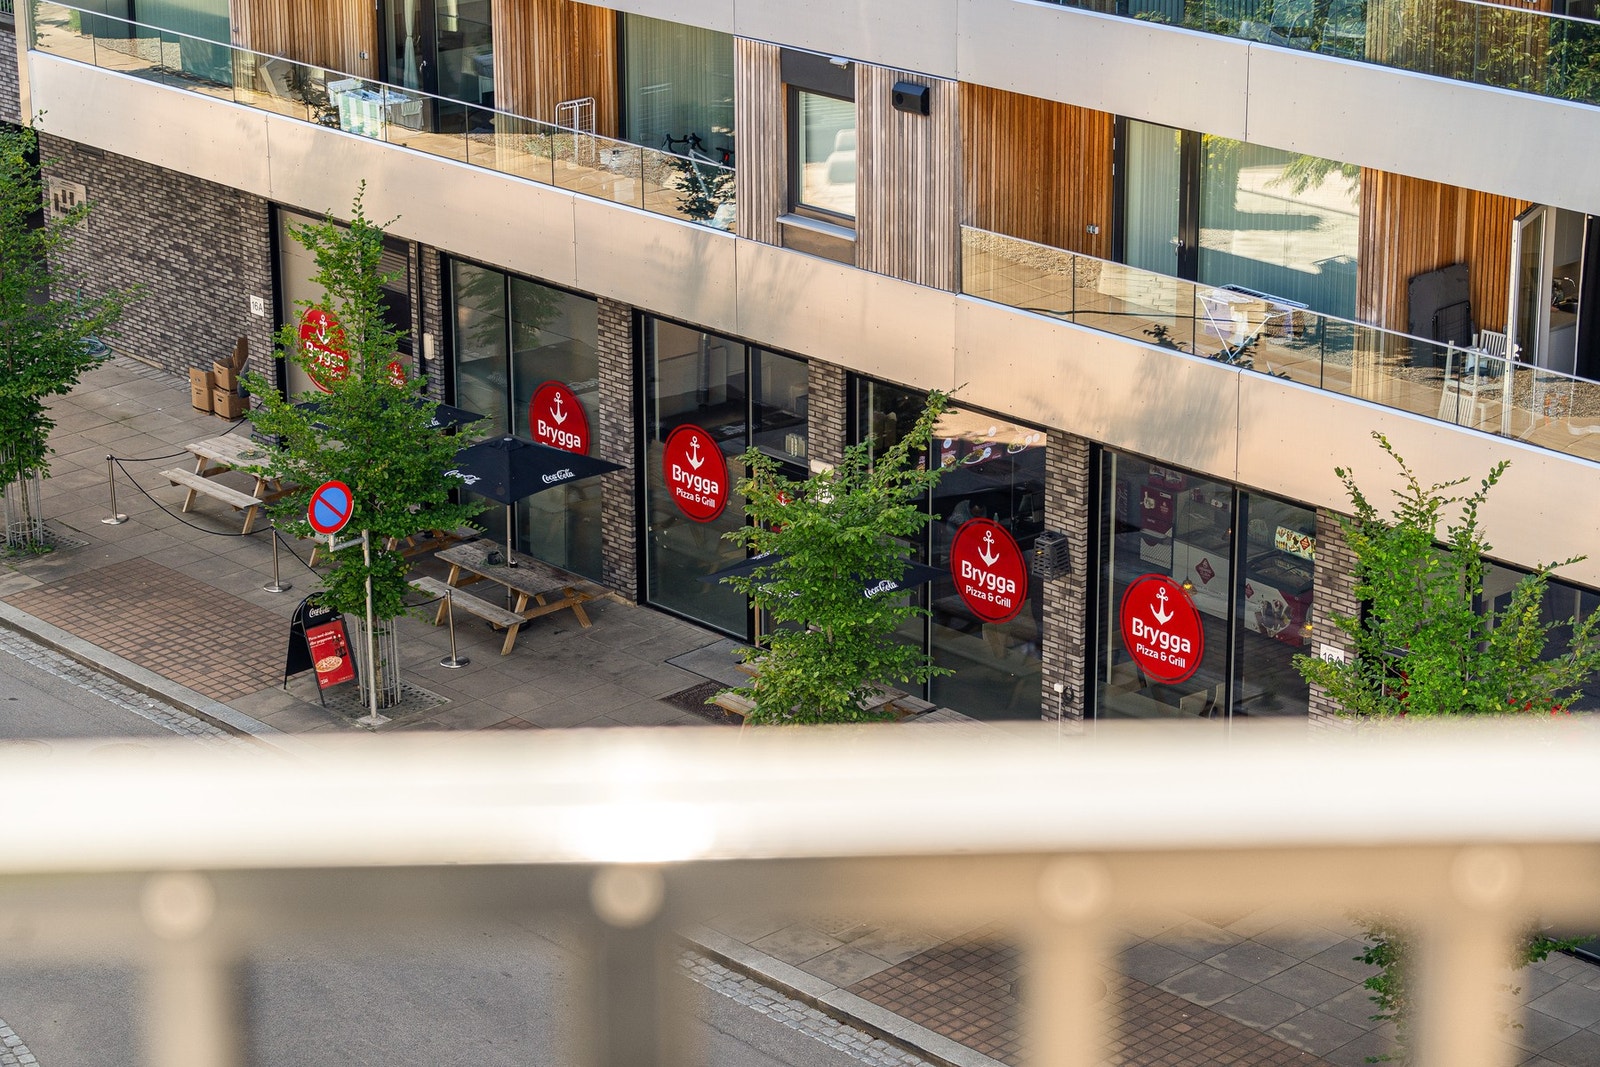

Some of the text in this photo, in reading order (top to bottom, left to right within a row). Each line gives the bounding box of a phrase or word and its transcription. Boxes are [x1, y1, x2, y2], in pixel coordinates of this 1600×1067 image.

[251, 301, 264, 312] 16A
[537, 419, 581, 448] Brygga
[672, 463, 719, 495] Brygga
[676, 487, 716, 508] Pizza & Grill
[961, 559, 1016, 594] Brygga
[965, 584, 1011, 608] Pizza & Grill
[1132, 617, 1191, 654] Brygga
[1136, 643, 1186, 669] Pizza & Grill
